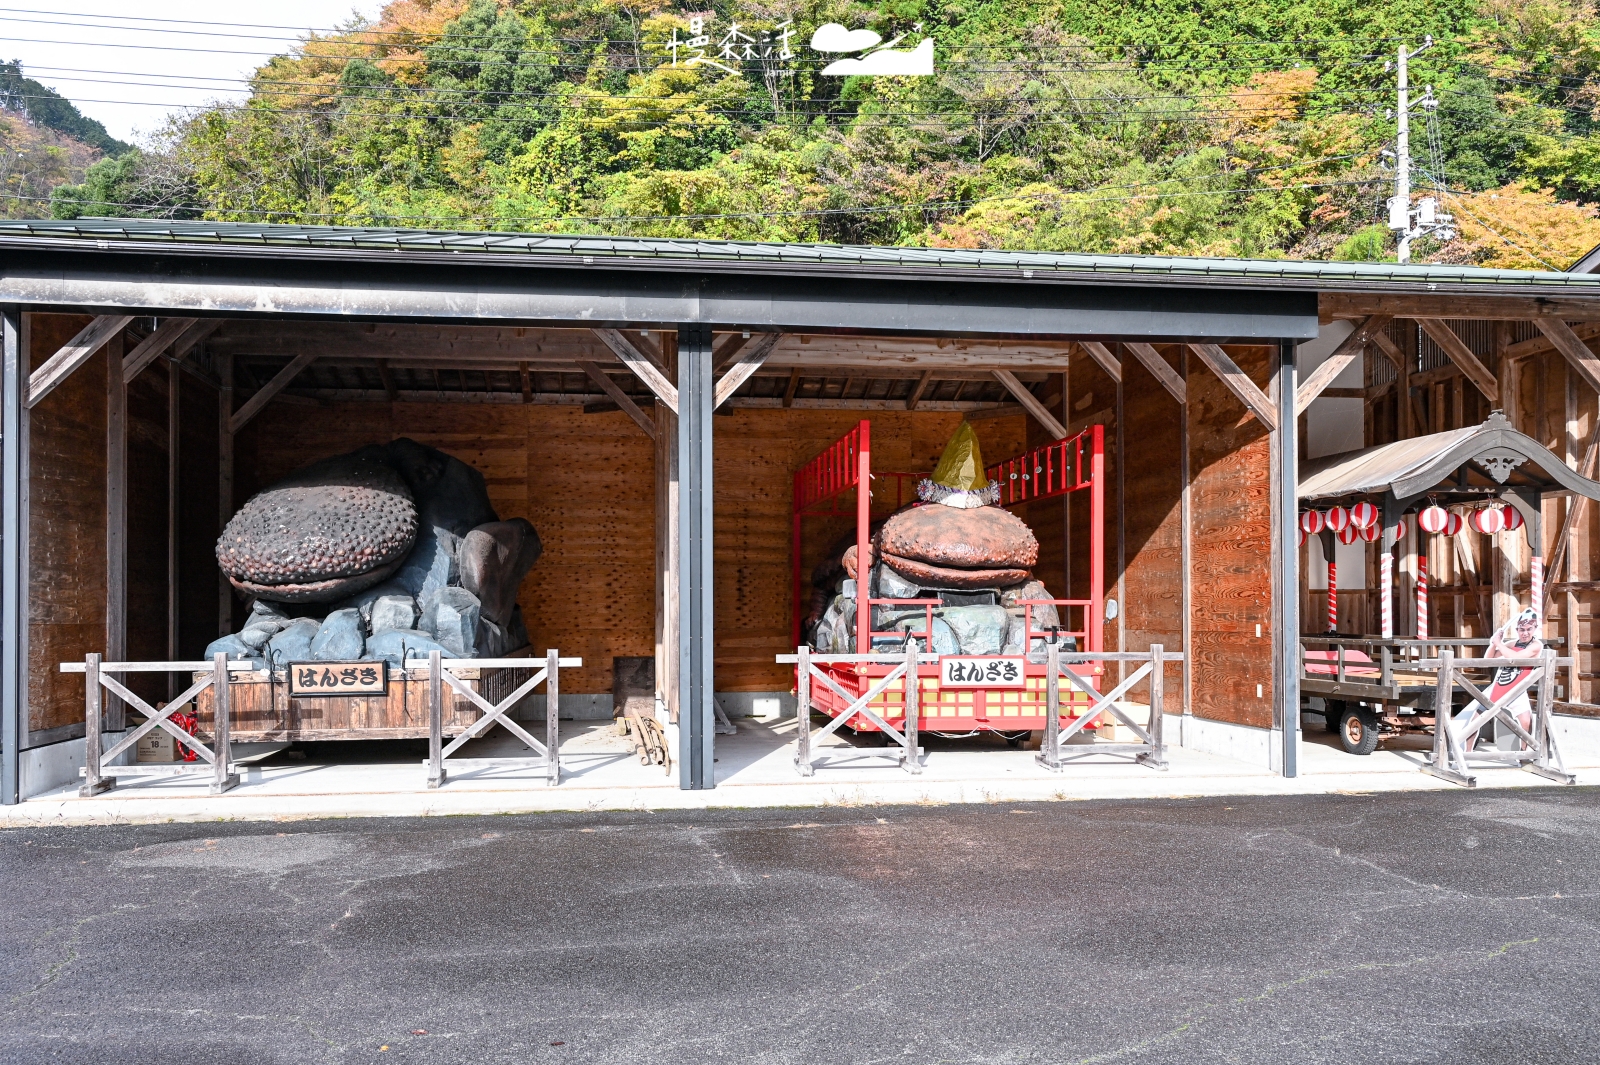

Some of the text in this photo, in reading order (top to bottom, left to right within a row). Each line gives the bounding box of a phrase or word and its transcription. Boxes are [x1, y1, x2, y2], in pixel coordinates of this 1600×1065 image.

[298, 667, 379, 688] はんざき
[948, 660, 1019, 682] はんざき
[150, 740, 160, 749] 18
